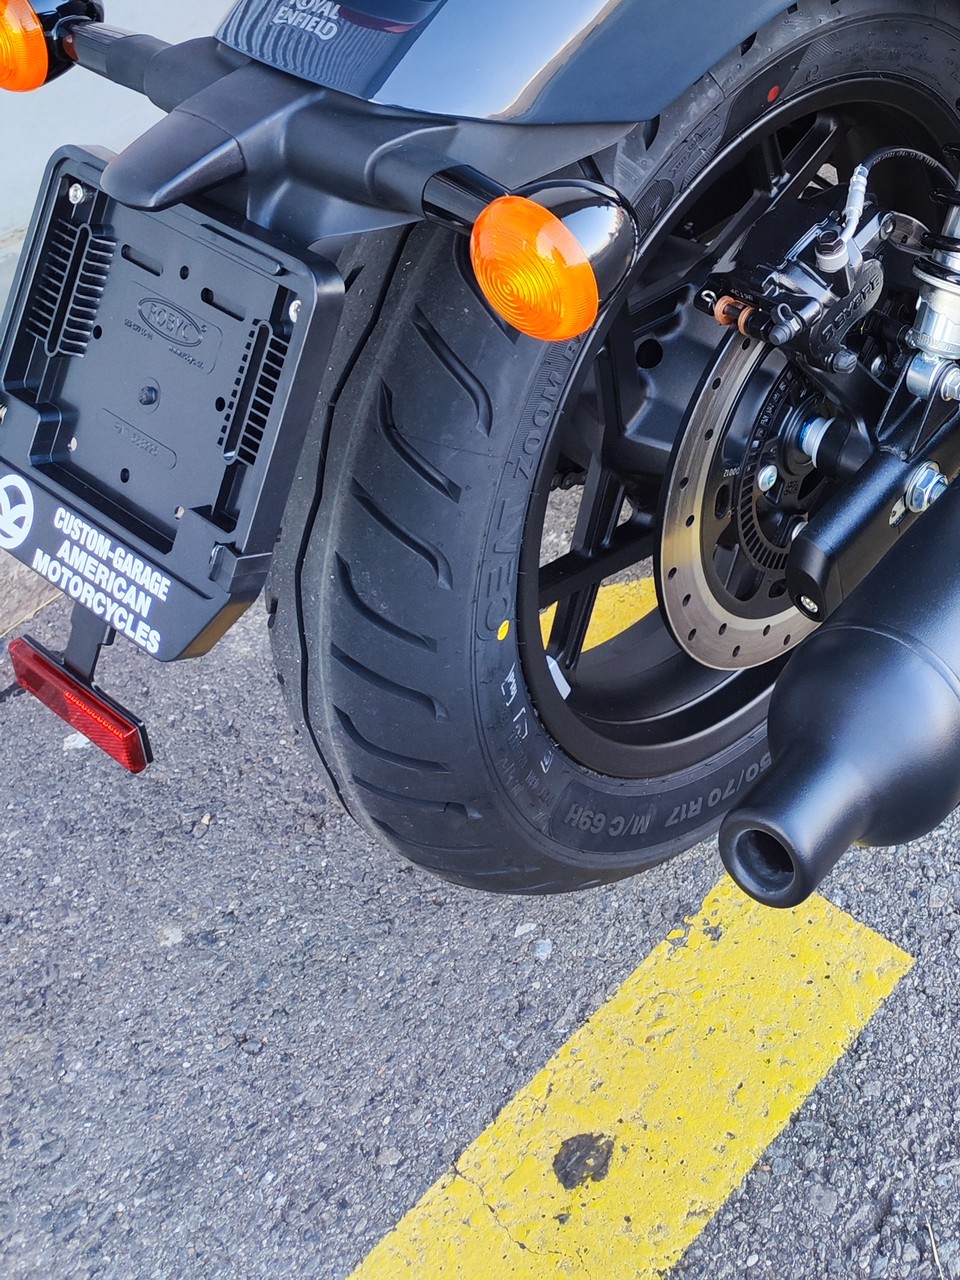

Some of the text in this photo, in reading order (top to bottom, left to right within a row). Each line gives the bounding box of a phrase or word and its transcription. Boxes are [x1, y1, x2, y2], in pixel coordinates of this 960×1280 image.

[271, 5, 338, 41] ENFIELD
[513, 370, 563, 481] ZOOM
[53, 506, 171, 602] CUSTOM-GARAGE
[56, 539, 152, 619] AMERICAN
[31, 548, 161, 654] MOTORCYCLES
[564, 752, 772, 838] 50/70 R17 M/C 69H
